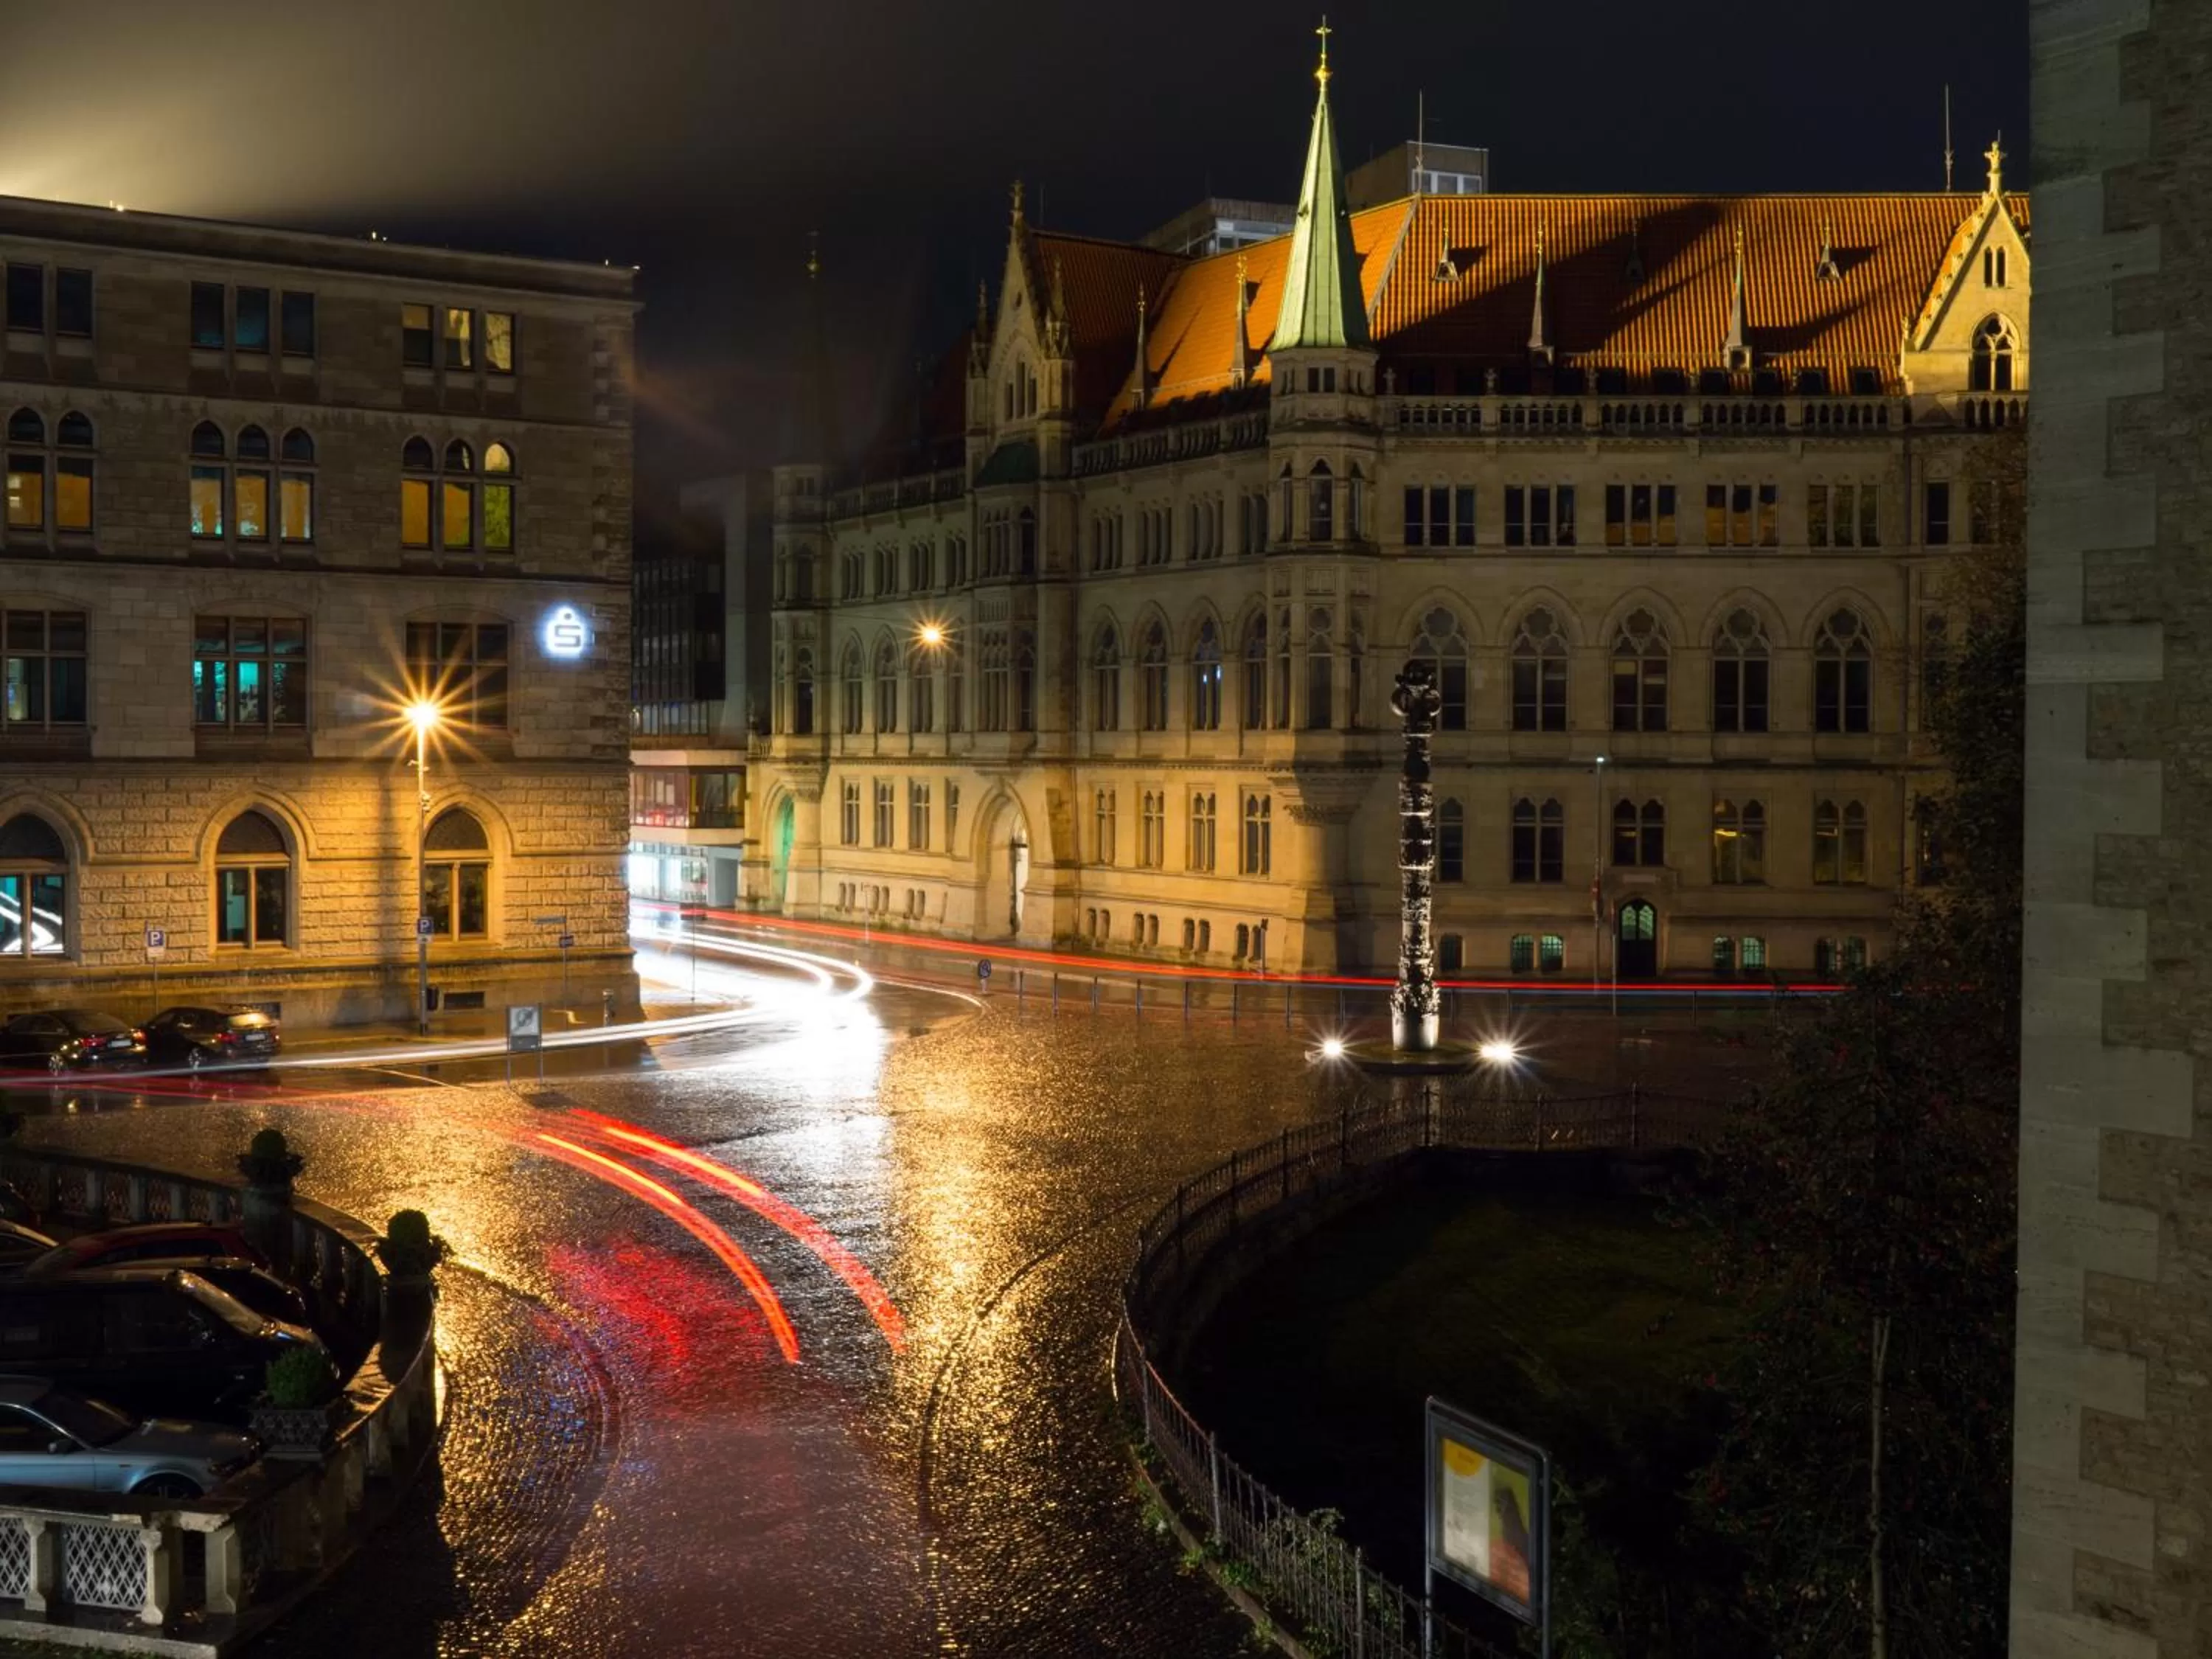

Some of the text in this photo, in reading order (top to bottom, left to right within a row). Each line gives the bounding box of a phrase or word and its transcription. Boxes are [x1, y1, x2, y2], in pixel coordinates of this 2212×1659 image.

[552, 618, 582, 650] S
[420, 919, 430, 933] P
[150, 931, 160, 945] P
